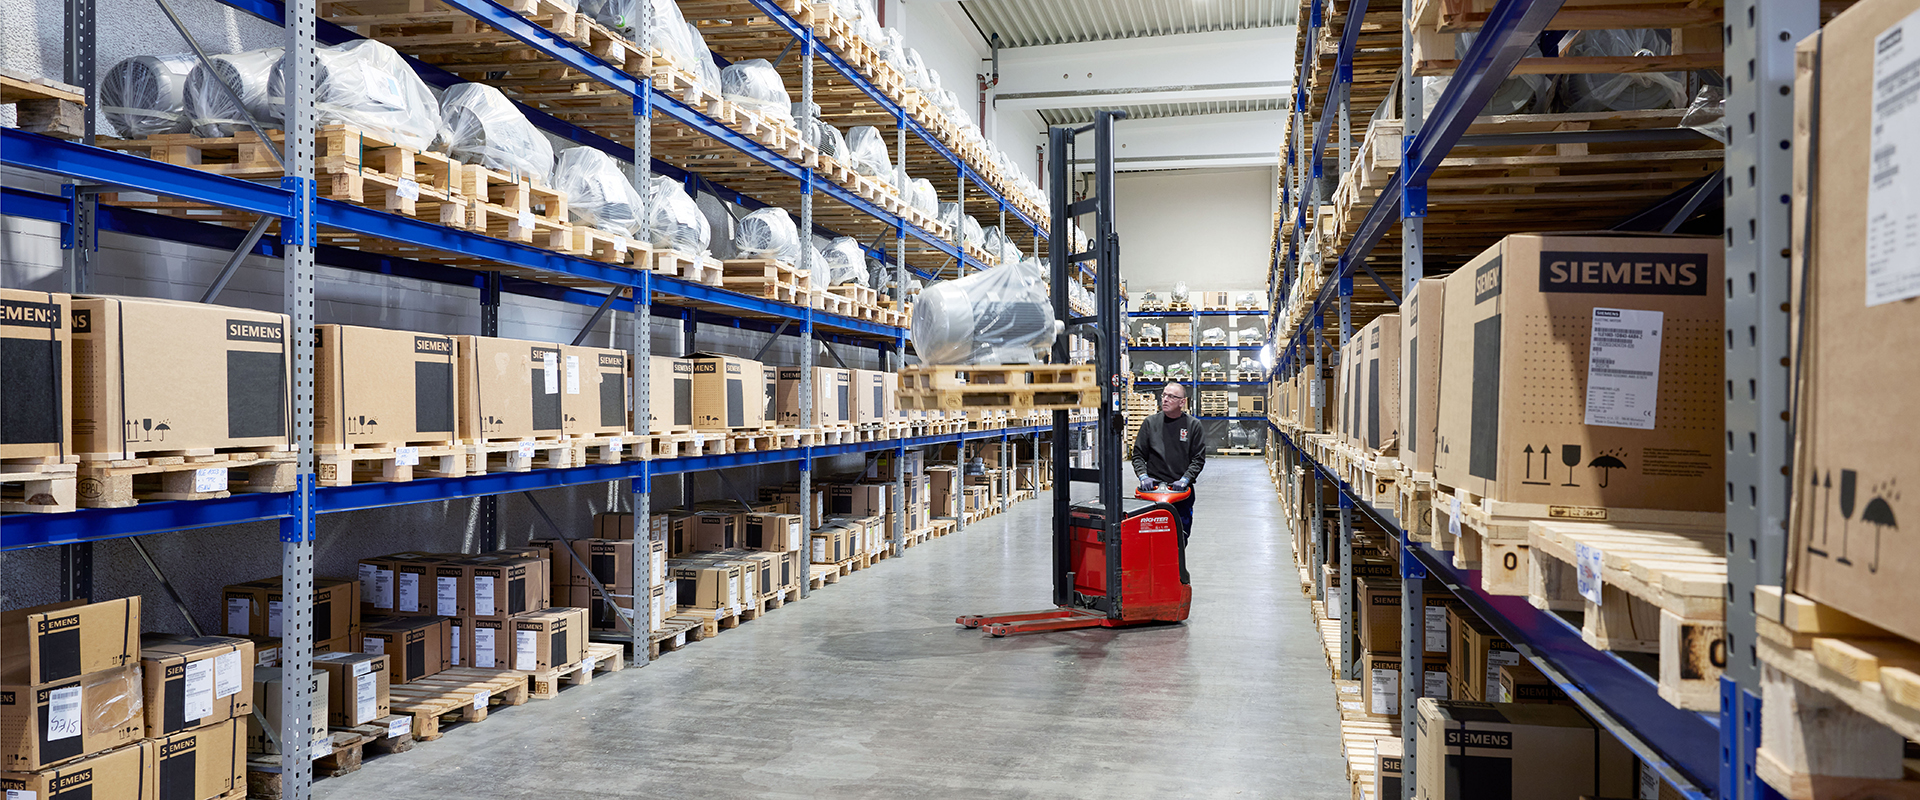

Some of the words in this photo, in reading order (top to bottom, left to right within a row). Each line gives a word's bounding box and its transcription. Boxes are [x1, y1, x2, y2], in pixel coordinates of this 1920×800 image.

[1550, 261, 1698, 286] SIEMENS
[0, 306, 57, 322] EMENS
[230, 324, 282, 339] SIEMENS
[416, 339, 452, 352] SIEMENS
[693, 364, 714, 372] MENS
[81, 482, 100, 495] EPAL
[1353, 566, 1391, 574] SIEMENS
[40, 617, 78, 631] SEMENS
[1491, 641, 1514, 649] SIEM
[167, 665, 184, 676] SIEM
[1373, 662, 1401, 670] SIEME
[1448, 732, 1509, 746] SIEMENS
[162, 738, 195, 755] SEMENS
[1, 781, 25, 790] MENS
[51, 771, 91, 790] SEMENS
